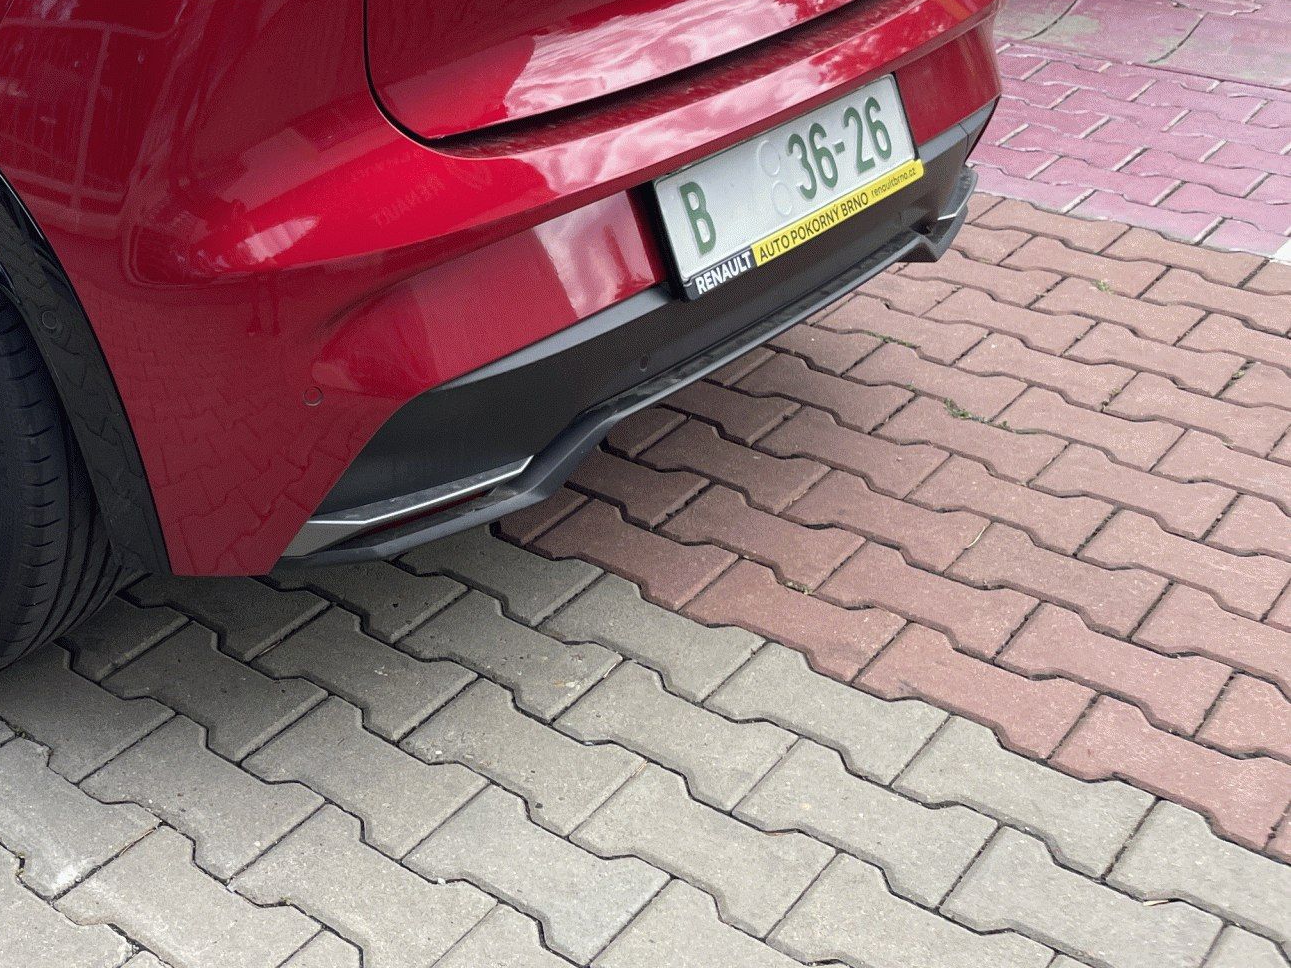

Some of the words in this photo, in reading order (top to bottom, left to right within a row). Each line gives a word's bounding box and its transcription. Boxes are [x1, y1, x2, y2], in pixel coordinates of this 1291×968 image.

[679, 181, 716, 256] B
[787, 96, 892, 200] 36-26
[695, 250, 753, 294] RENAULT
[759, 235, 790, 262] AUTO
[790, 205, 840, 242] POKORNÝ
[840, 191, 869, 217] BRNO
[871, 167, 917, 198] renaultbrno.cz
